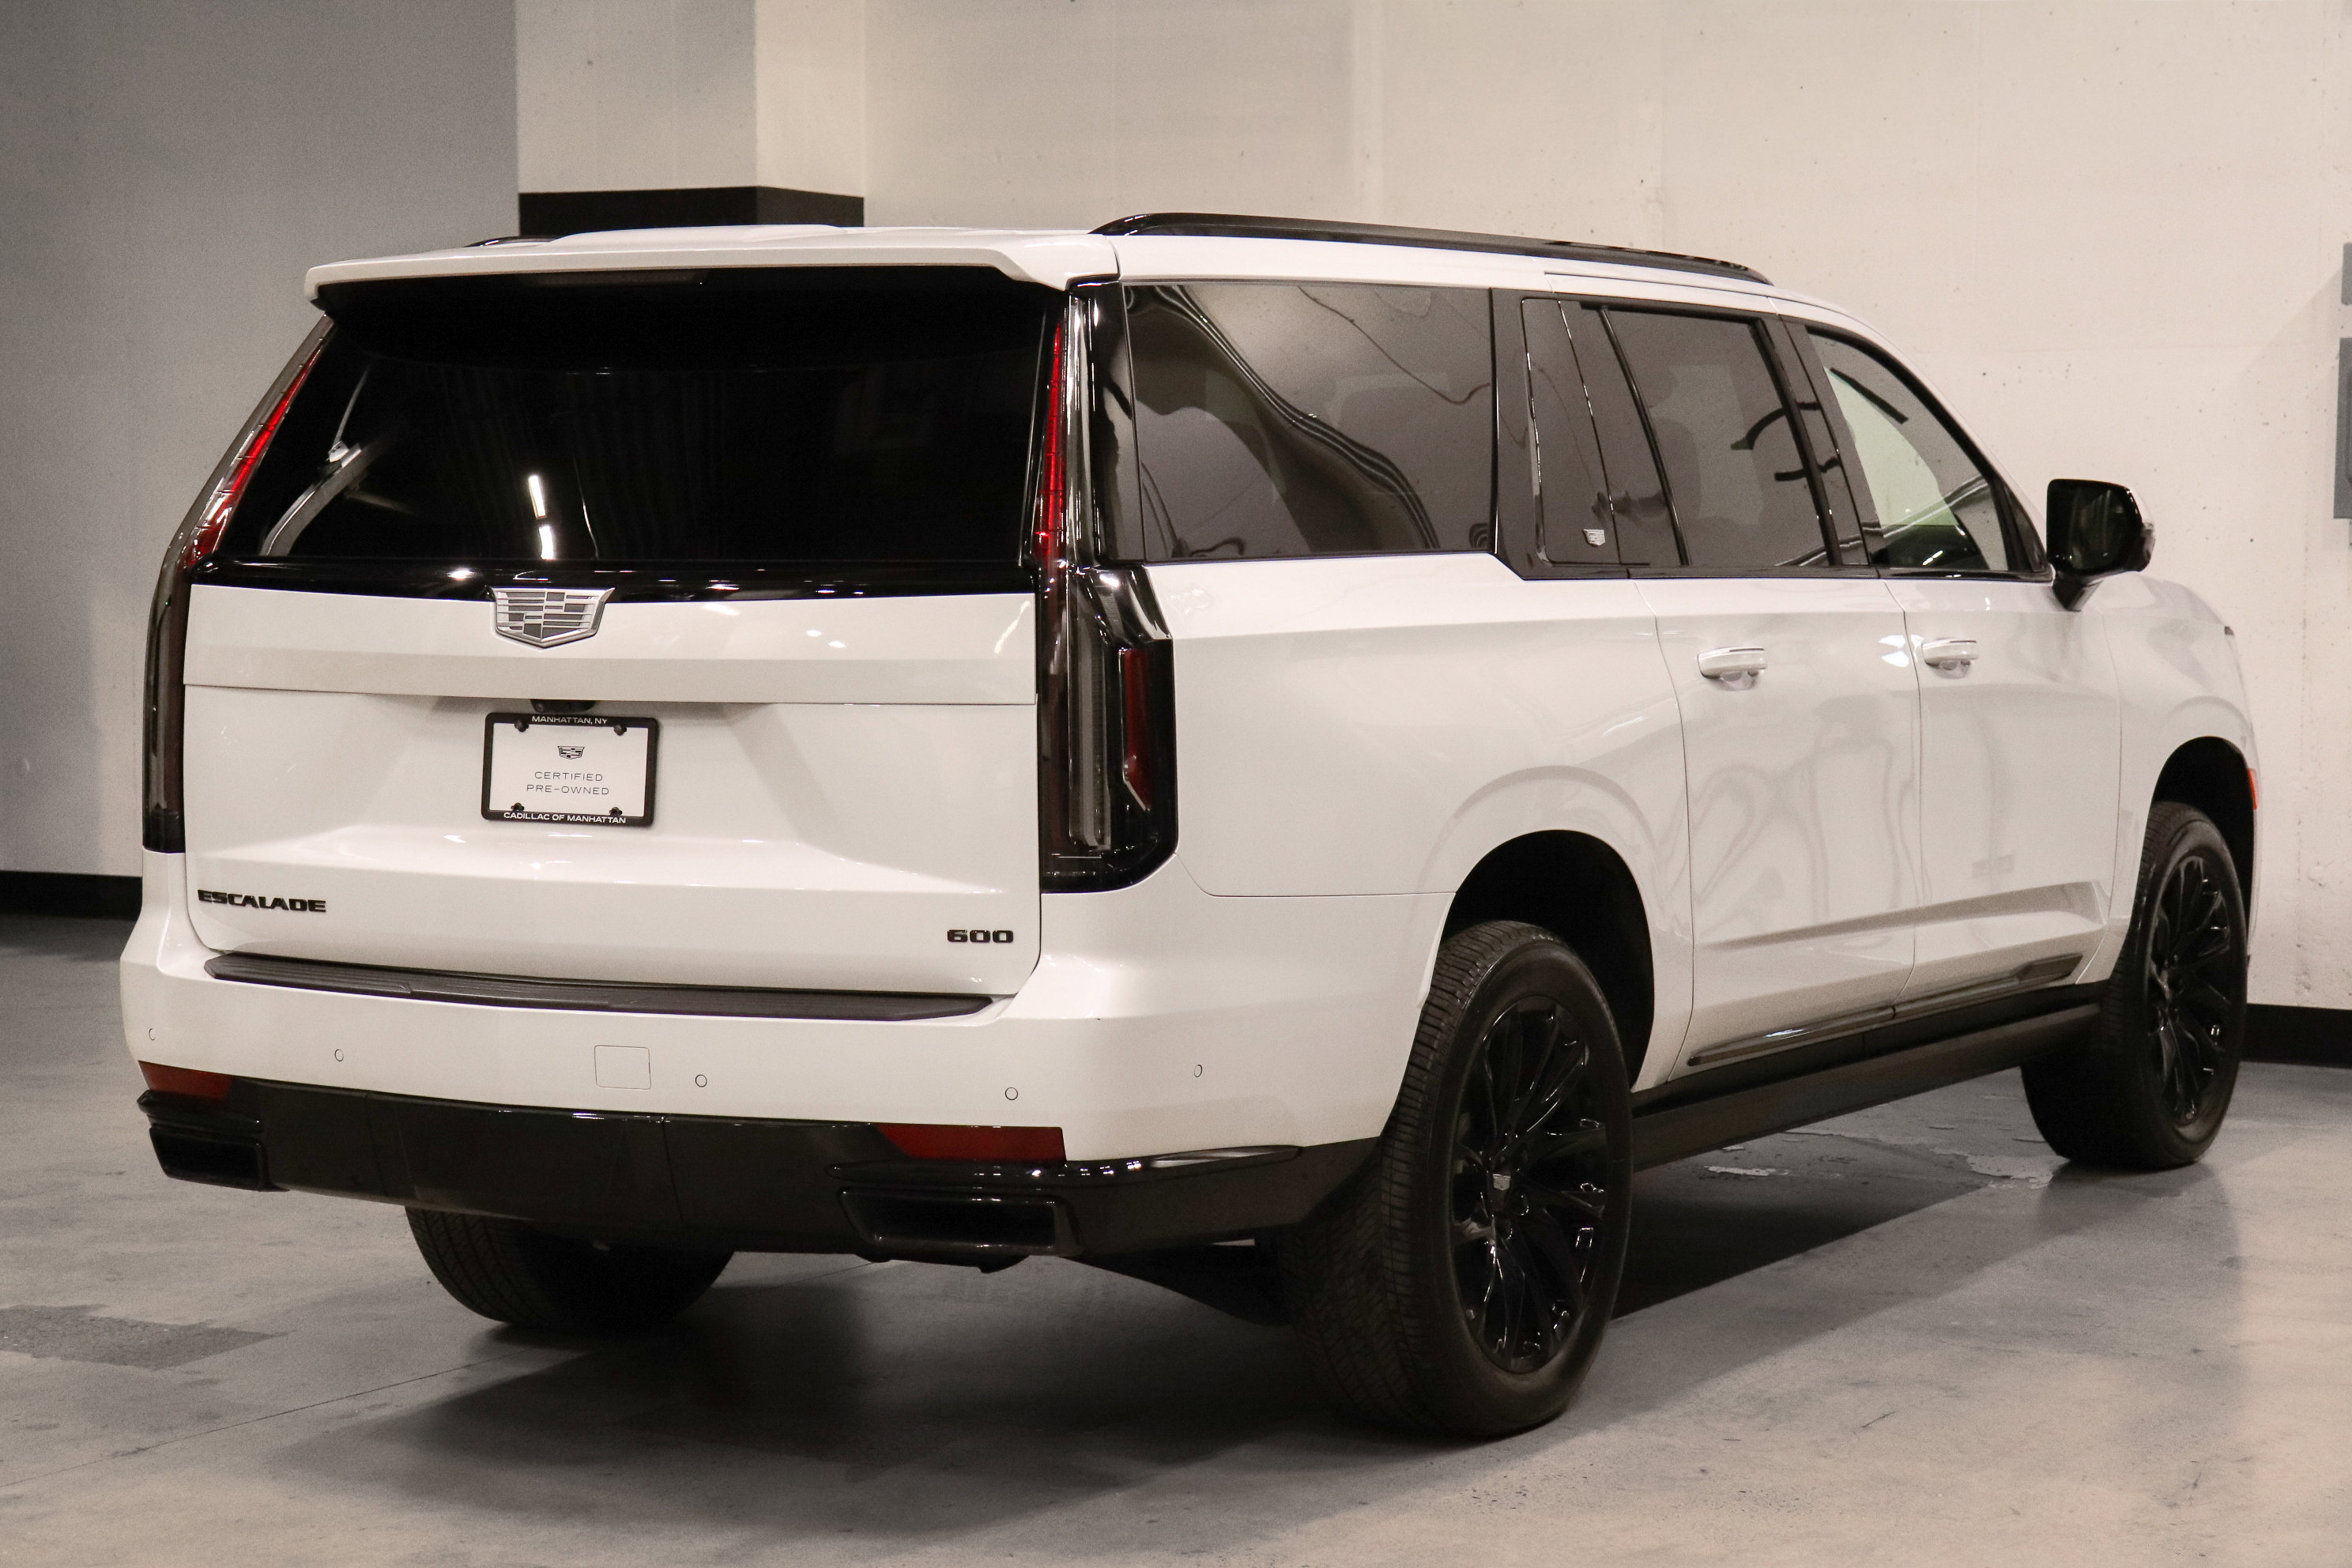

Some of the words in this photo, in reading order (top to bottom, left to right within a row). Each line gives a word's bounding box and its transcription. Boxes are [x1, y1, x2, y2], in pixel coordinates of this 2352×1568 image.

[532, 715, 593, 726] MANHATTAN,
[534, 771, 603, 782] CERTIFIED
[526, 784, 609, 795] PRE-OWNED
[503, 812, 551, 821] CADILLAC
[567, 815, 626, 824] MANHATTAN
[198, 889, 326, 913] ESCALADE
[947, 929, 1014, 944] 600
